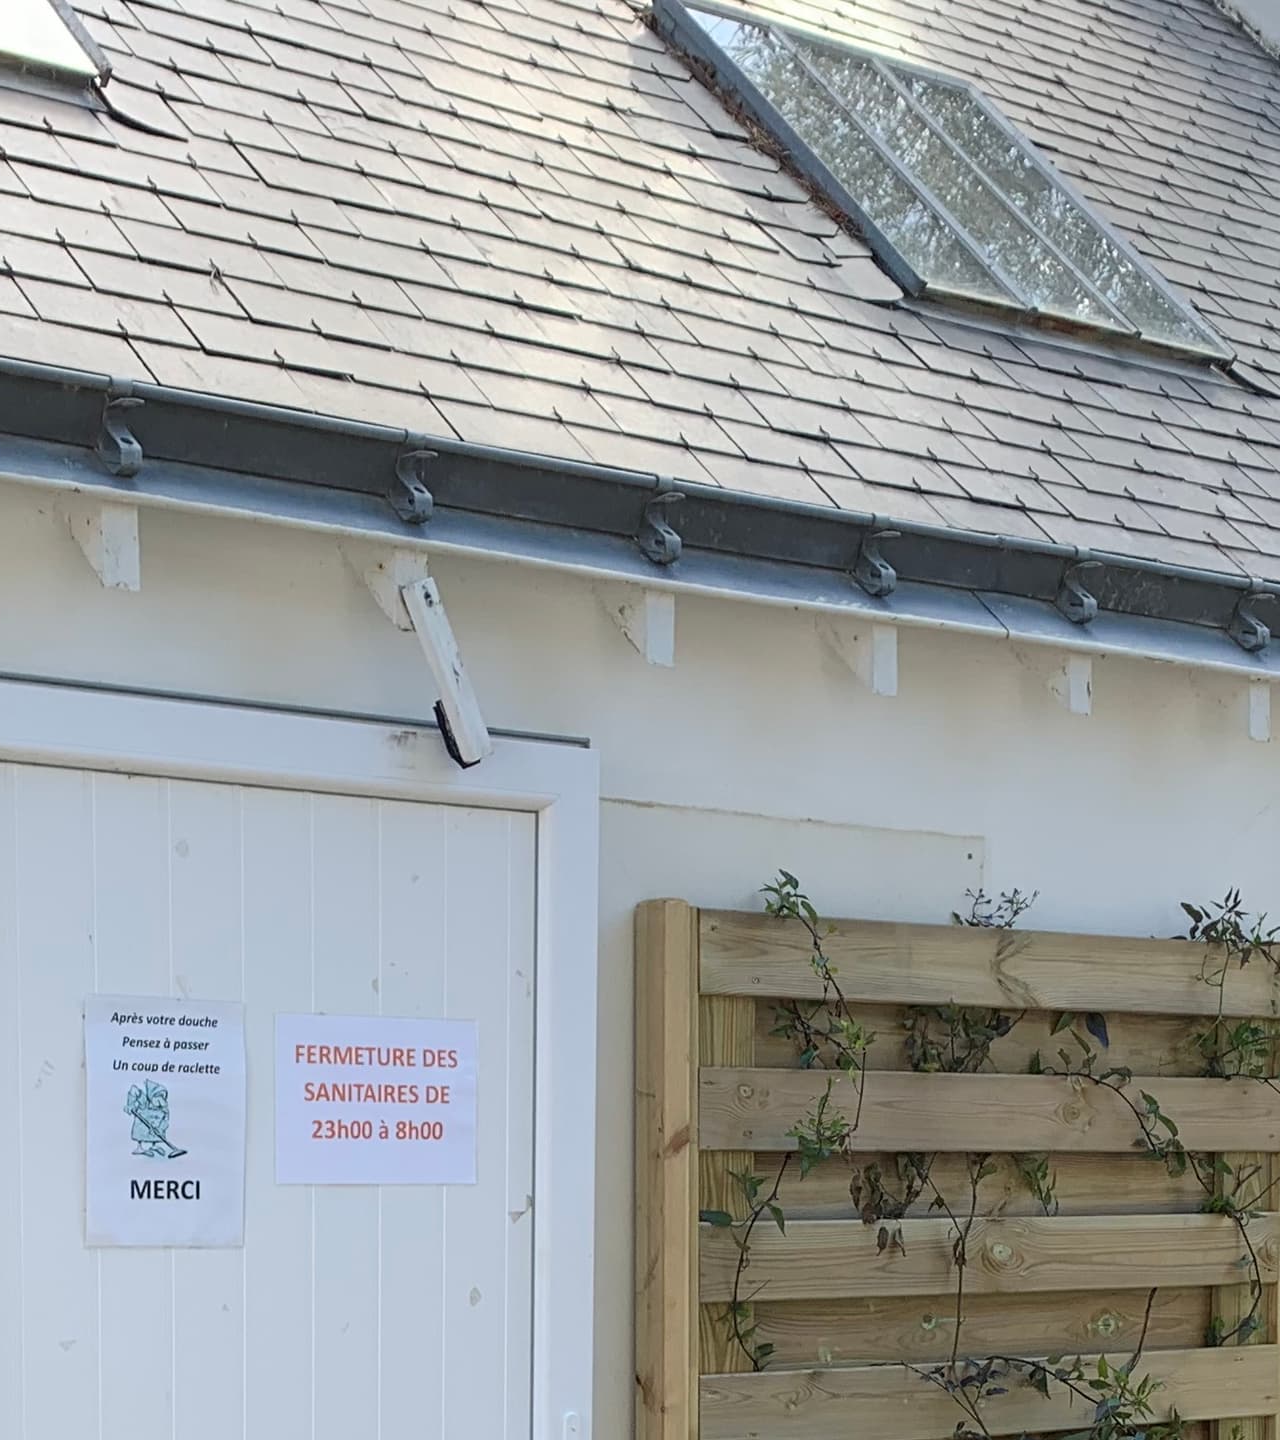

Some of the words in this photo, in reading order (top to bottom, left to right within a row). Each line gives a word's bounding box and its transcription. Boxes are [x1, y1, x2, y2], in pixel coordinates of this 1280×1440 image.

[110, 1011, 144, 1026] Après
[146, 1014, 176, 1026] votre
[178, 1014, 218, 1028] douche
[122, 1036, 161, 1049] Pensez
[163, 1037, 171, 1049] à
[173, 1040, 210, 1052] passer
[295, 1044, 417, 1067] FERMETURE
[422, 1049, 458, 1068] DES
[112, 1059, 129, 1072] Un
[131, 1061, 159, 1073] coup
[161, 1061, 175, 1073] de
[177, 1062, 221, 1075] raclette
[303, 1082, 420, 1104] SANITAIRES
[425, 1085, 450, 1104] DE
[311, 1118, 373, 1140] 23h00
[378, 1119, 389, 1140] à
[395, 1120, 444, 1141] 8h00
[130, 1179, 201, 1200] MERCI
